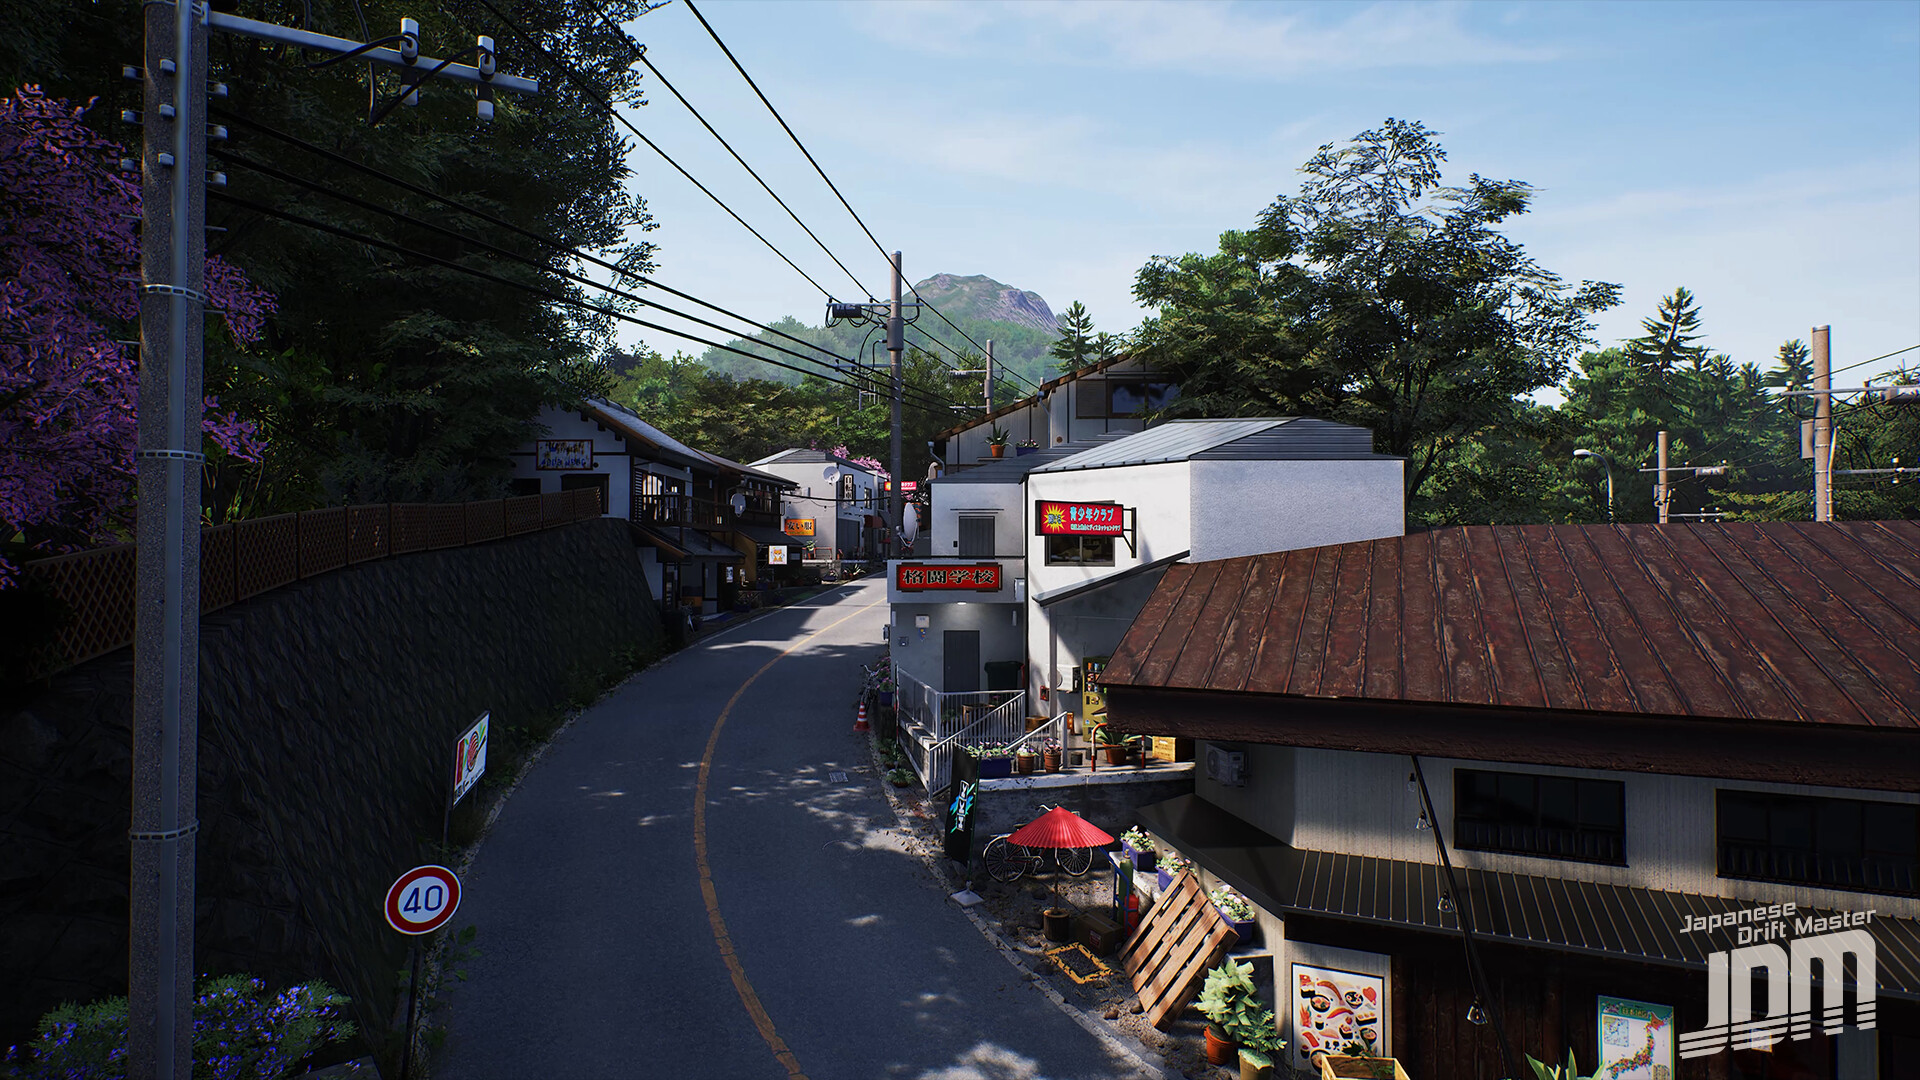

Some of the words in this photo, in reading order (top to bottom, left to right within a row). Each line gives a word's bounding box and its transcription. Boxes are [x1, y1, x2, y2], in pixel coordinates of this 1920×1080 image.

[1069, 505, 1115, 522] 青少年クラブ
[903, 569, 995, 584] 格闘学校
[403, 884, 443, 913] 40
